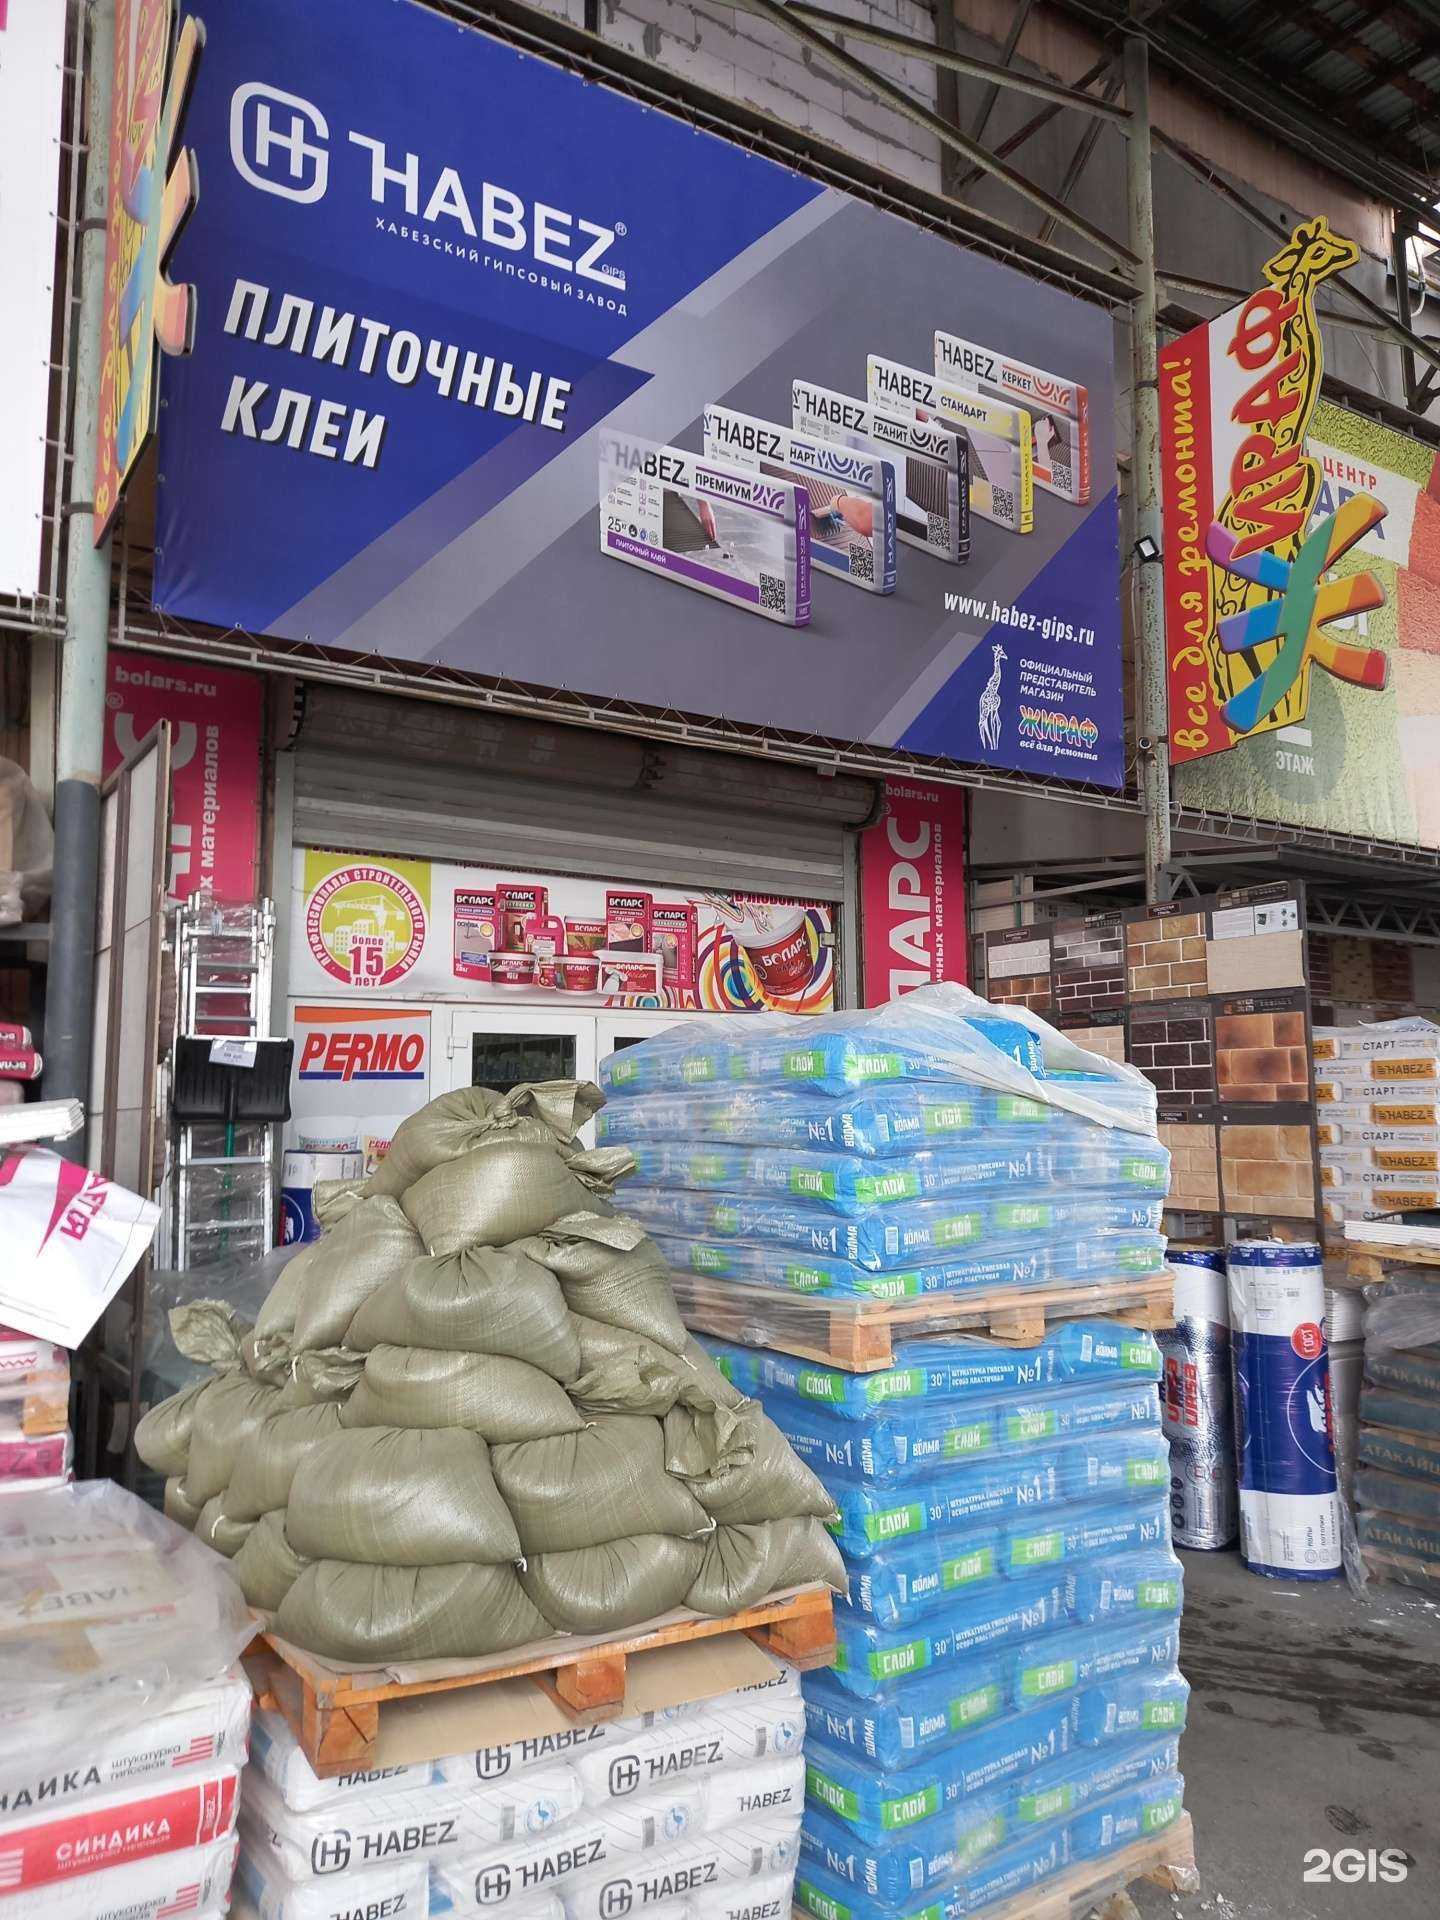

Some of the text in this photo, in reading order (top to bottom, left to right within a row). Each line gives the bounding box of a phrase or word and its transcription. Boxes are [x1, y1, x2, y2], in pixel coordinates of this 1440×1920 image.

[348, 130, 626, 290] HABEZ
[376, 217, 628, 317] ХАБЕЗСКИЙ ГИПСОВЫЙ ЗАВОД
[223, 278, 572, 430] ПЛИТОЧНЫЕ
[938, 338, 998, 384] HABEZ
[875, 366, 936, 408] HABEZ
[1002, 369, 1032, 391] КЕРКЕТ
[220, 375, 386, 468] КЛЕИ
[801, 391, 868, 434] HABEZ
[940, 395, 987, 422] СТАНДАРТ
[714, 416, 784, 462] HABEZ
[873, 421, 908, 443] ГРАНИТ
[789, 447, 815, 465] НАРТ
[1322, 455, 1377, 490] ЦЕНТР
[695, 473, 751, 500] ПРЕМИУМ
[1162, 356, 1211, 752] все для ремонта!
[944, 592, 1095, 647] www.habez-gips.ru
[115, 665, 217, 697] bolars.ru
[1019, 658, 1093, 684] ОФИЦИАЛЬНЫЙ
[1019, 671, 1097, 698] ПРЕДСТАВИТЕЛЬ
[1020, 685, 1064, 702] МАГАЗИН
[1018, 704, 1099, 749] ЖИРАФ
[1036, 742, 1053, 753] для
[1054, 745, 1098, 761] ремонта
[1276, 750, 1316, 777] ЭТАЖ
[201, 725, 221, 868] материалов
[885, 783, 939, 803] bolars.ru
[934, 823, 945, 927] материалов
[308, 869, 424, 970] ПРОФЕССИОНАЛЫ СТРОИТЕЛЬНОГО РЫНКА
[886, 816, 931, 1002] ЛАРС
[352, 935, 384, 945] более
[349, 946, 384, 976] 15
[355, 976, 377, 987] лет
[299, 1032, 424, 1081] PERMO
[1362, 1040, 1396, 1051] СТАРТ
[789, 1052, 814, 1073] СЛОЙ
[1384, 1063, 1426, 1075] HABEZ
[1363, 1086, 1396, 1096] СТАРТ
[1385, 1110, 1427, 1121] HABEZ
[1362, 1131, 1395, 1141] СТАРТ
[797, 1168, 824, 1193] СЛОЙ
[875, 1172, 907, 1197] СЛОЙ
[1362, 1173, 1396, 1183] СТАРТ
[1302, 1328, 1316, 1353] ГОСТ
[880, 1371, 912, 1395] СЛОЙ
[1017, 1356, 1042, 1385] №1
[805, 1374, 832, 1396] СЛОЙ
[825, 1439, 854, 1467] №1
[1016, 1475, 1042, 1505] №1
[879, 1510, 910, 1535] СЛОЙ
[1140, 1516, 1160, 1542] №1
[953, 1553, 982, 1578] СЛОЙ
[1021, 1597, 1045, 1631] №1
[883, 1646, 916, 1673] СЛОЙ
[826, 1712, 855, 1745] №1
[111, 1744, 182, 1770] штукатурка
[644, 1740, 724, 1779] HABEZ
[1030, 1728, 1056, 1765] №1
[110, 1759, 166, 1782] гипсовая
[736, 1788, 792, 1812] HABEZ
[892, 1794, 926, 1822] СЛОЙ
[56, 1817, 171, 1861] СИНДИКА
[357, 1818, 459, 1860] HABEZ
[515, 1838, 607, 1888] HABEZ
[826, 1849, 856, 1882] №1
[637, 1861, 719, 1903] HABEZ
